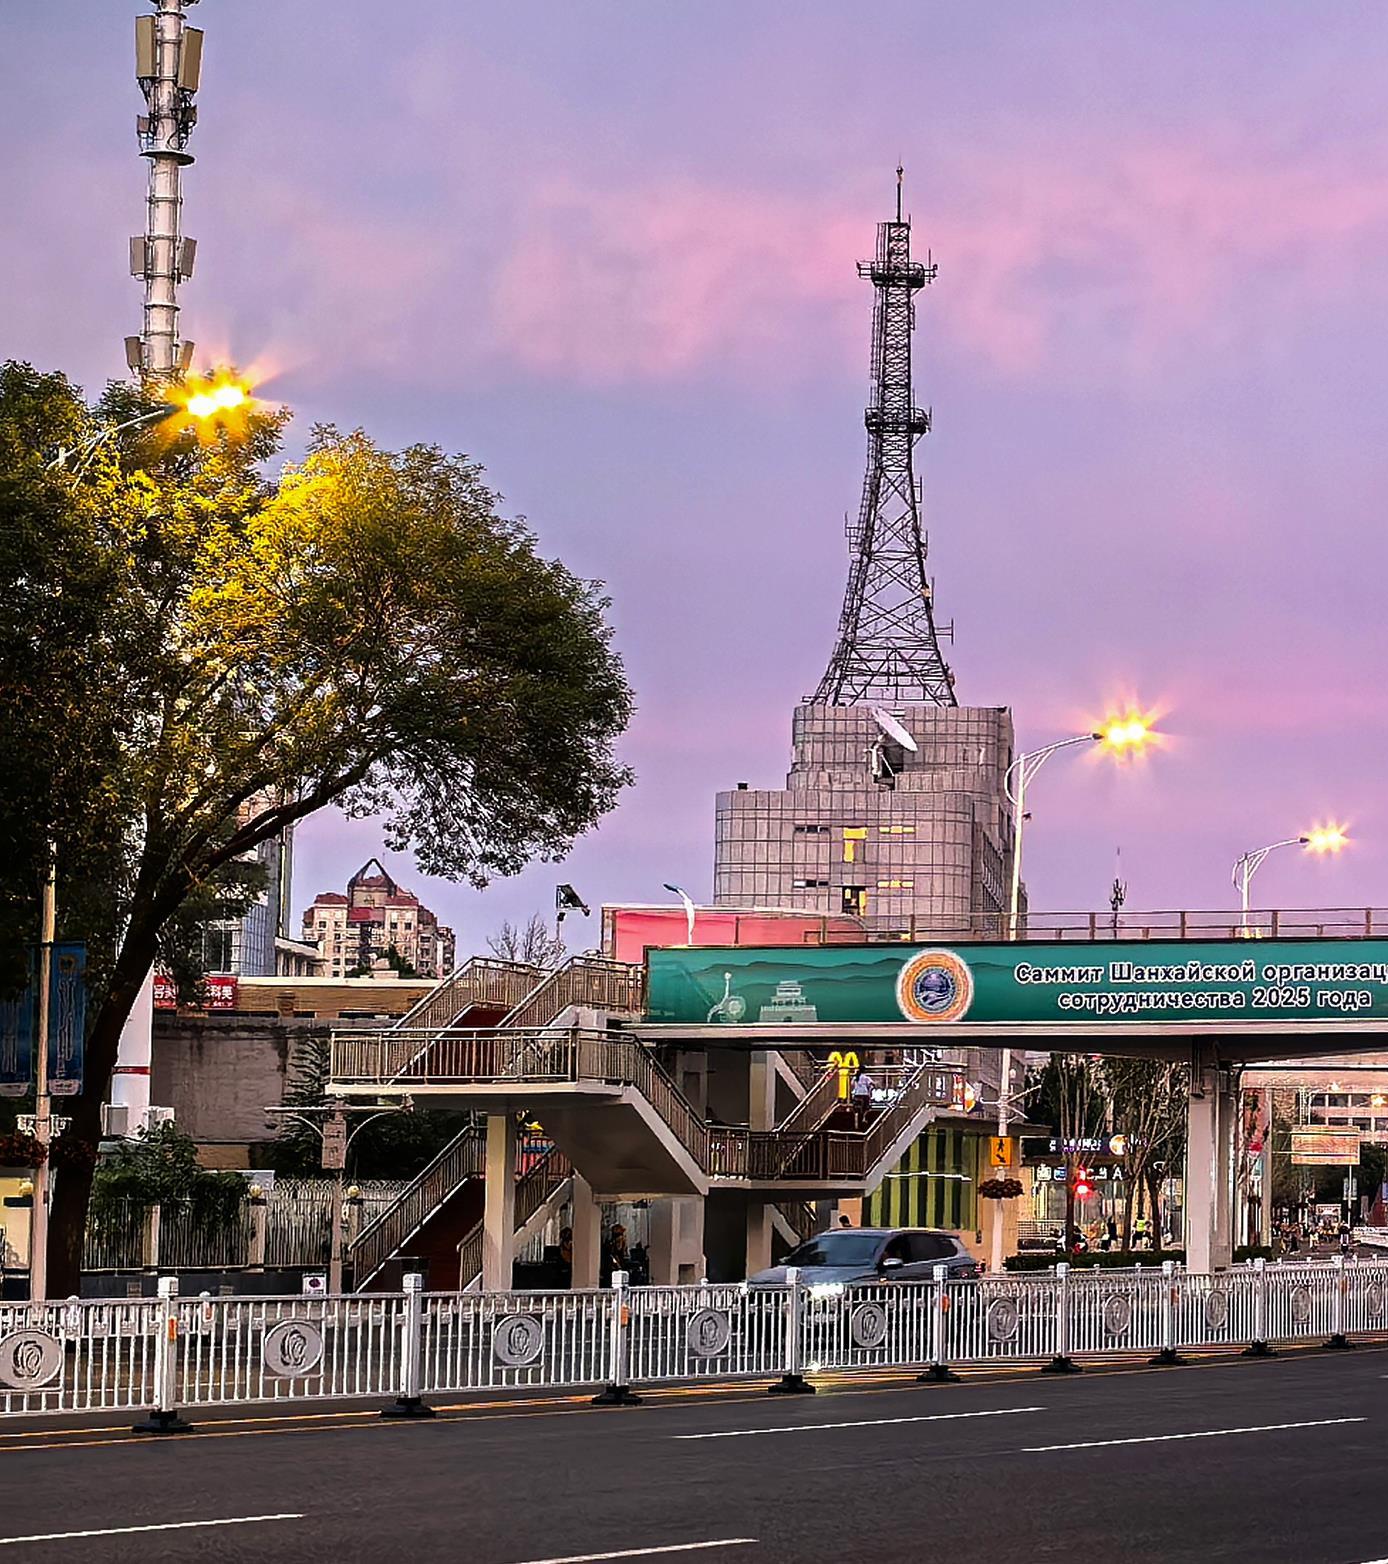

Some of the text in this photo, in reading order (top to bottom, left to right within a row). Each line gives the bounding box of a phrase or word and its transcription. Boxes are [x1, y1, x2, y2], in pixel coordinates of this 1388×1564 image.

[1015, 963, 1102, 984] Саммит
[1109, 960, 1255, 983] Шанхайской
[1058, 987, 1372, 1014] сотрудничества 2025 года
